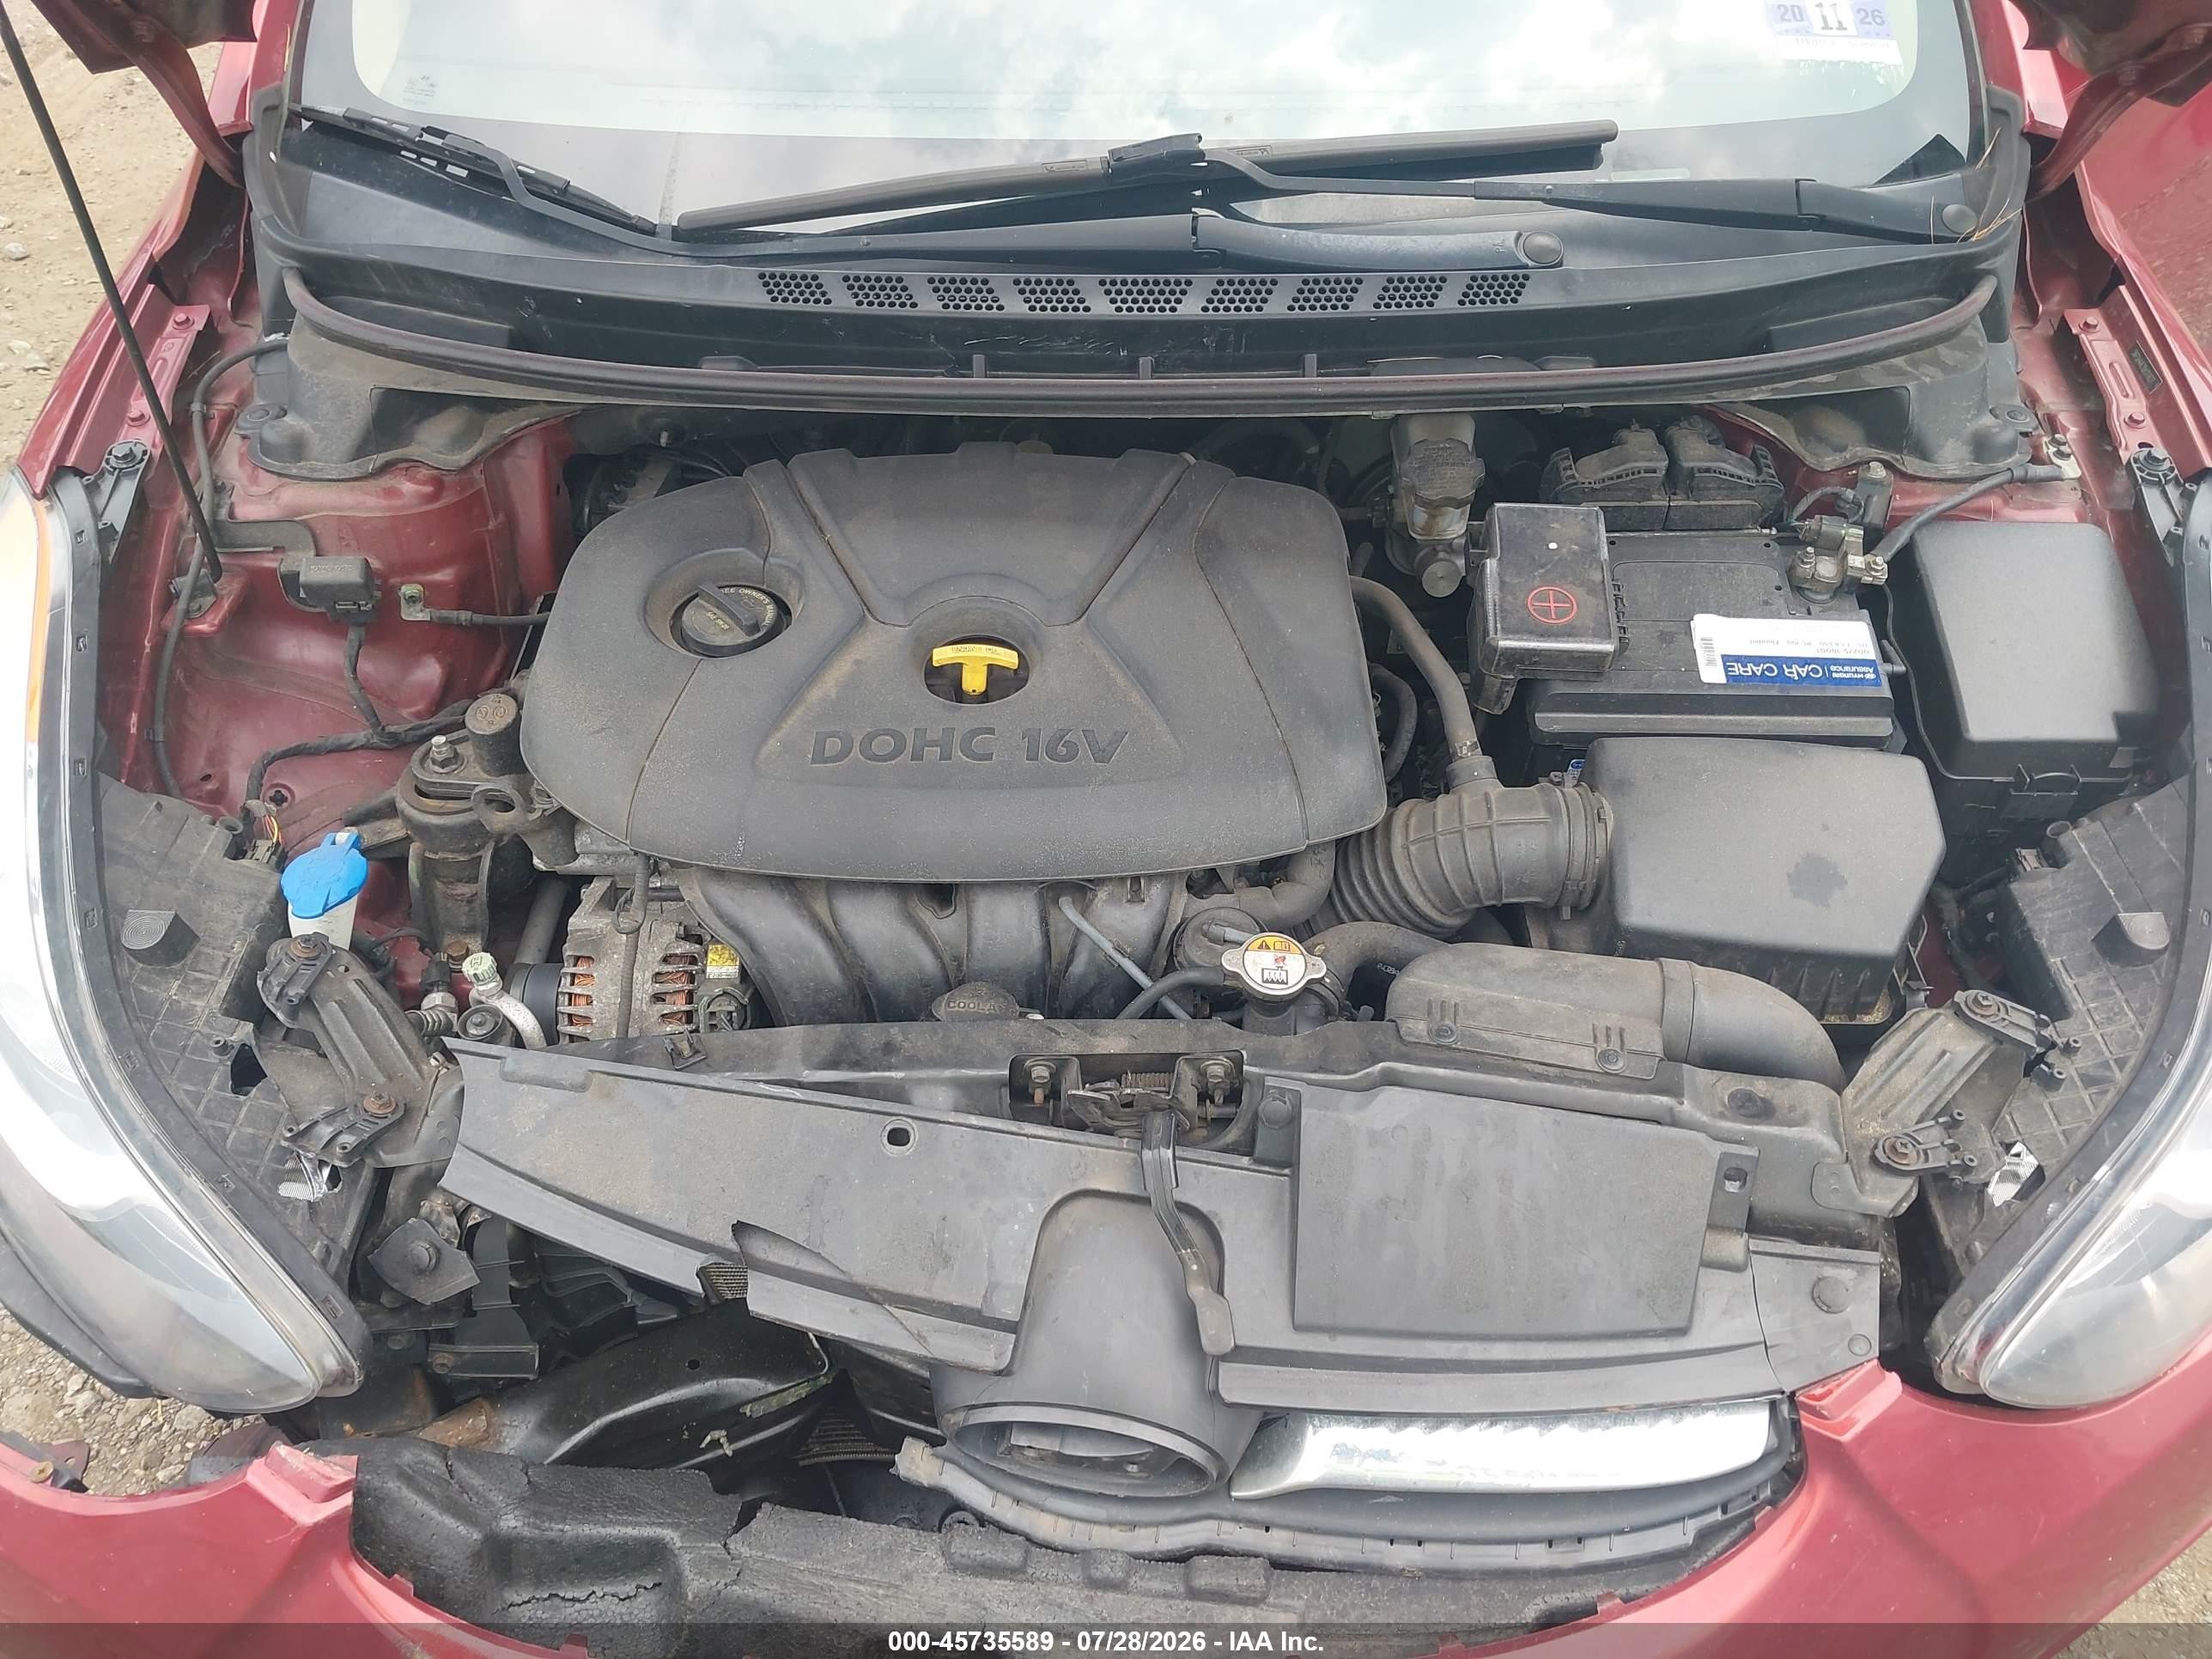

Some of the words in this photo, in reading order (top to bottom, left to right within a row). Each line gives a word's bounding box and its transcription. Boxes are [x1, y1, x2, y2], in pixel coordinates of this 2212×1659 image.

[1777, 3, 1804, 22] 20
[1814, 2, 1848, 31] 11
[1856, 8, 1886, 27] 26
[1727, 662, 1778, 677] CARE
[1783, 664, 1822, 680] CAR
[810, 726, 996, 765] DOHC
[1020, 727, 1128, 764] 16V
